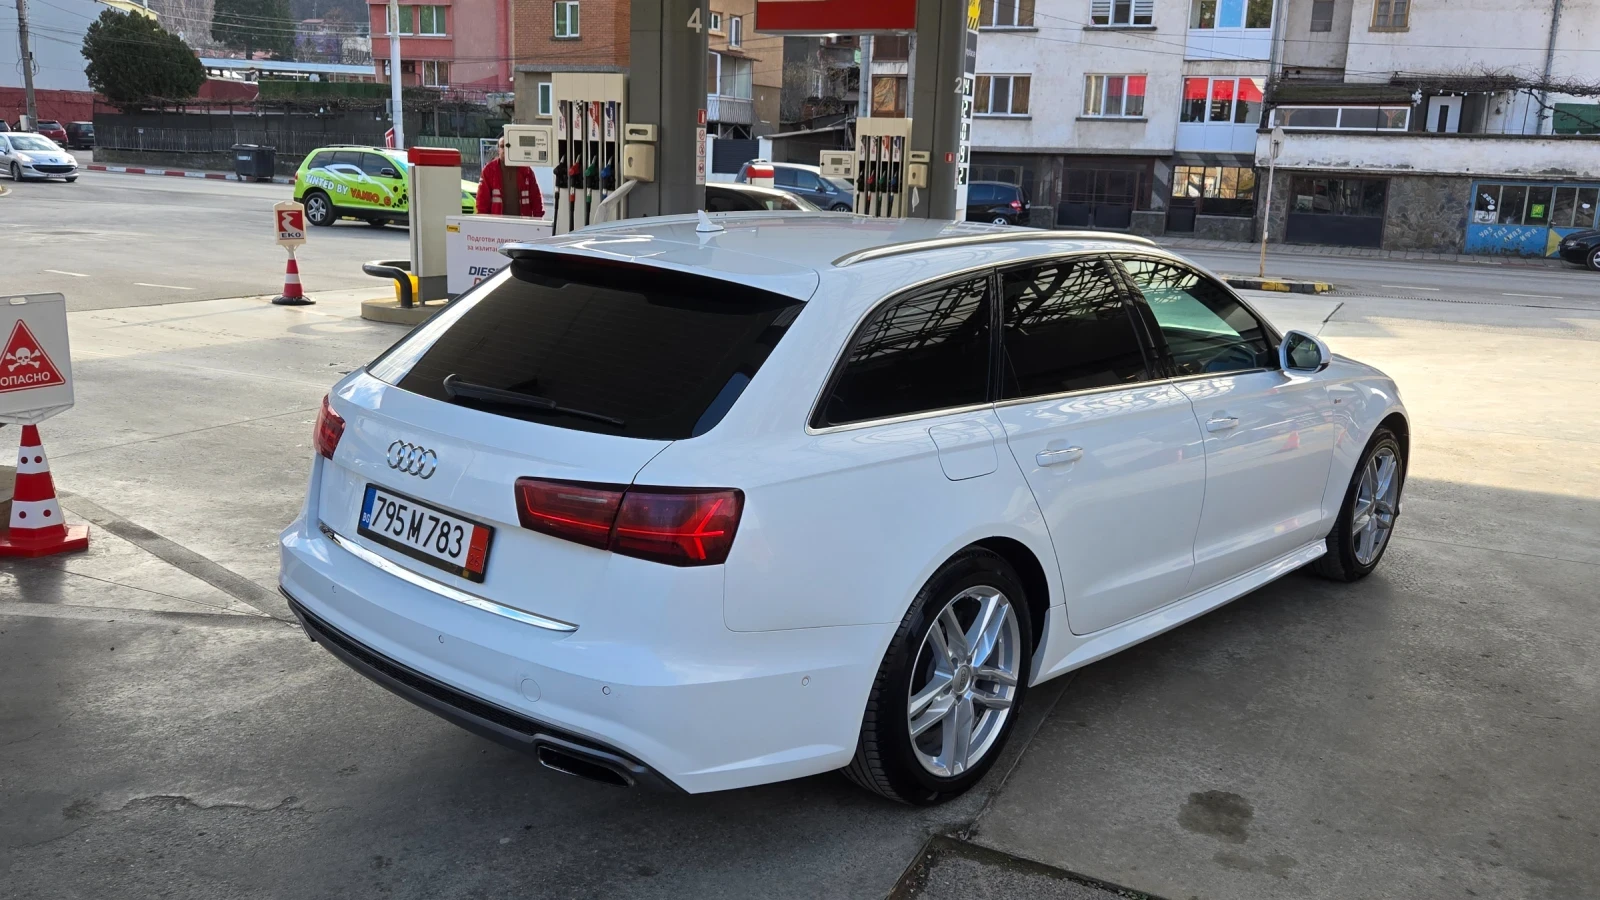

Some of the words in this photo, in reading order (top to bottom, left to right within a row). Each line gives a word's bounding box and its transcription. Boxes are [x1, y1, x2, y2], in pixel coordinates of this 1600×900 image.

[687, 8, 702, 33] 4
[954, 76, 963, 94] 2
[305, 173, 335, 190] TINTED
[336, 184, 349, 195] BY
[466, 234, 495, 243] Подготви
[468, 265, 498, 277] DIES
[0, 371, 51, 387] ОПАСНО
[361, 511, 371, 524] BG
